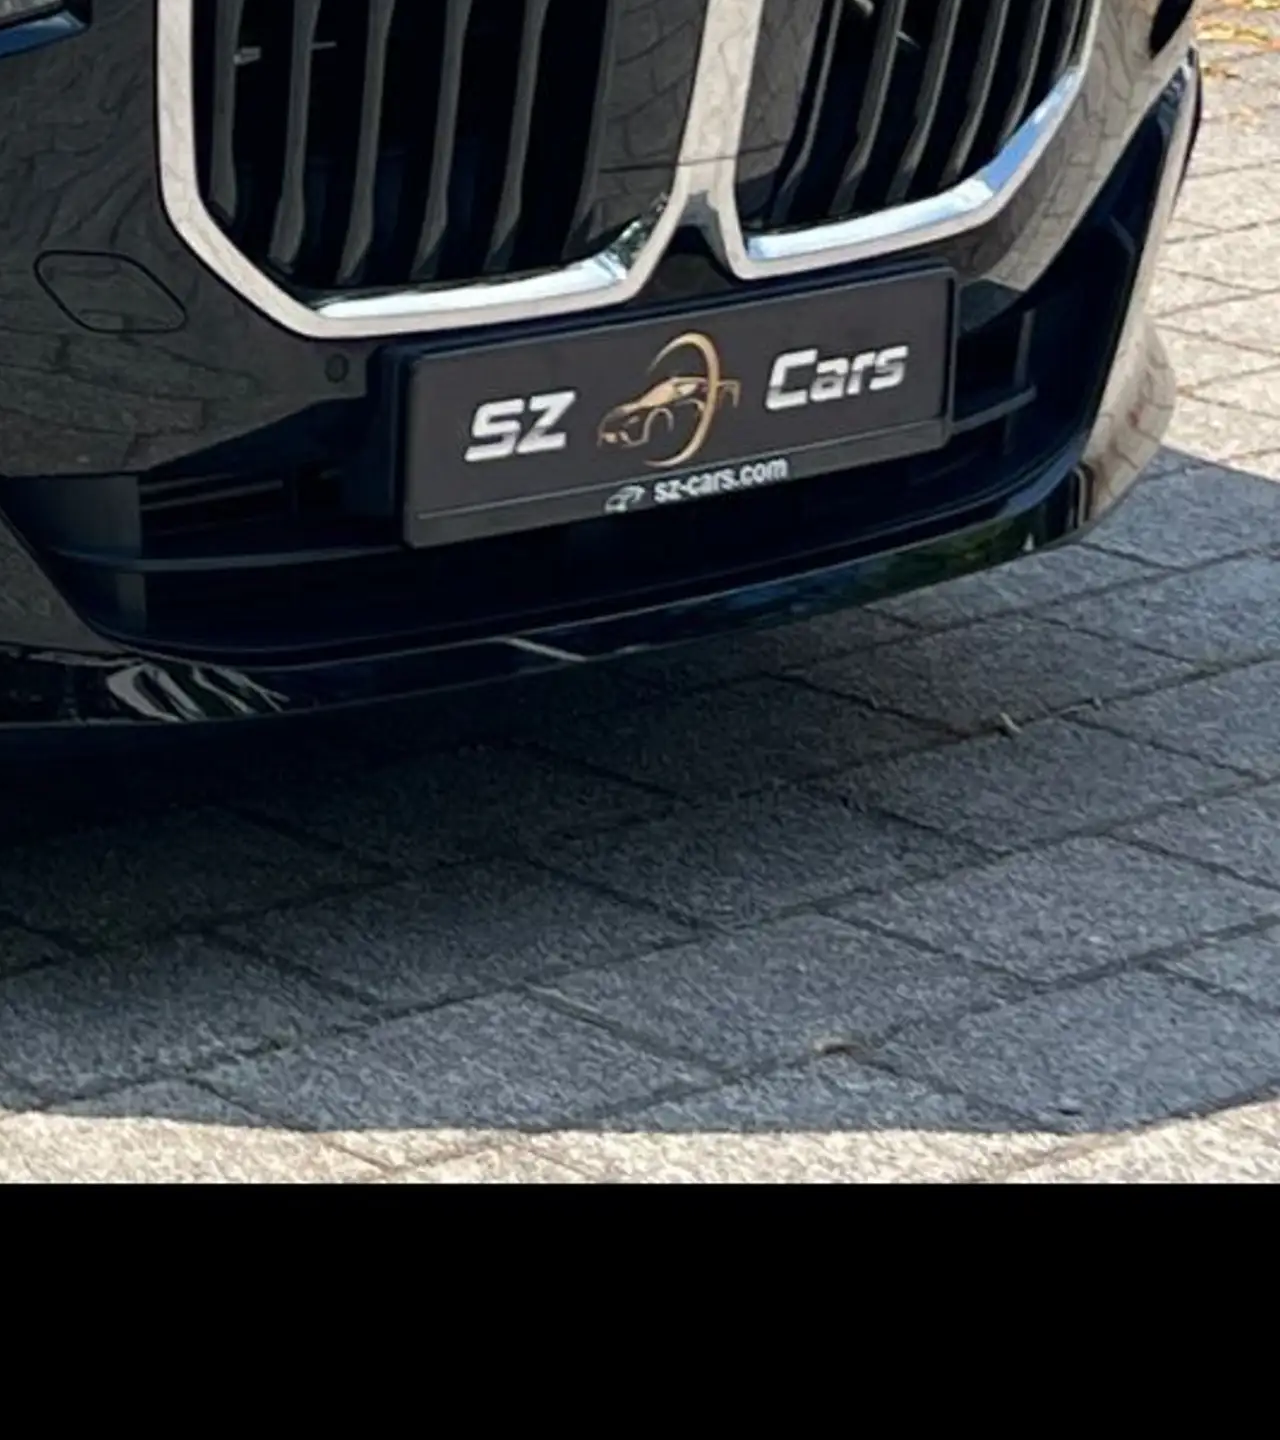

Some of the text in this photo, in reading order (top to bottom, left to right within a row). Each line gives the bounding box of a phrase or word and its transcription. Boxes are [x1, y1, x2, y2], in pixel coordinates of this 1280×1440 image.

[464, 345, 909, 462] SZ Cars
[653, 456, 788, 503] sz-cars.com
